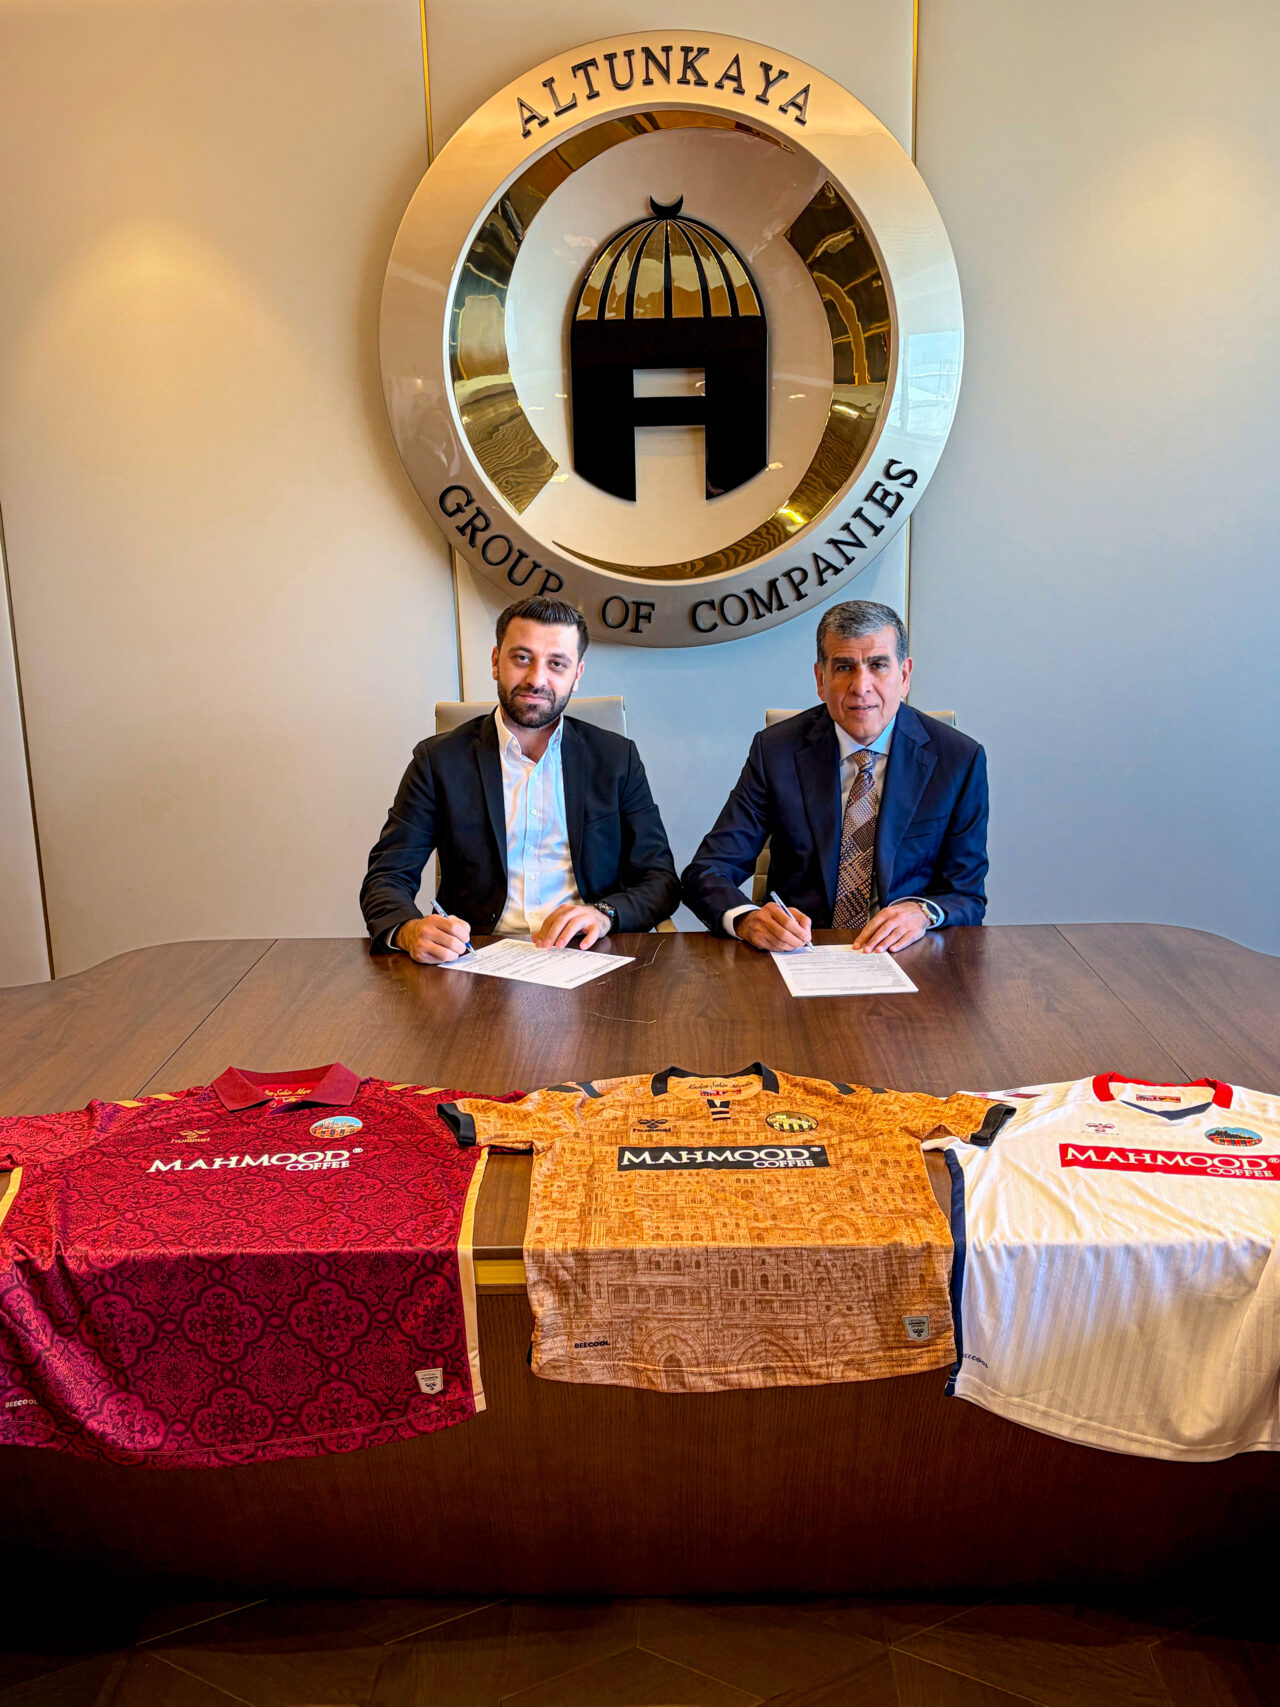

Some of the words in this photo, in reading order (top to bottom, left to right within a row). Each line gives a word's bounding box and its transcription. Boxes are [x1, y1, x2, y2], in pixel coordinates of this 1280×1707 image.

[516, 45, 814, 139] ALTUNKAYA
[438, 484, 565, 597] GROUP
[601, 595, 656, 634] OF
[690, 458, 919, 634] COMPANIES
[285, 1160, 350, 1171] COFFEE
[752, 1159, 815, 1168] COFFEE
[1206, 1167, 1275, 1178] COFFEE
[574, 1340, 611, 1349] BEECOOL
[4, 1399, 39, 1409] BEECOOL
